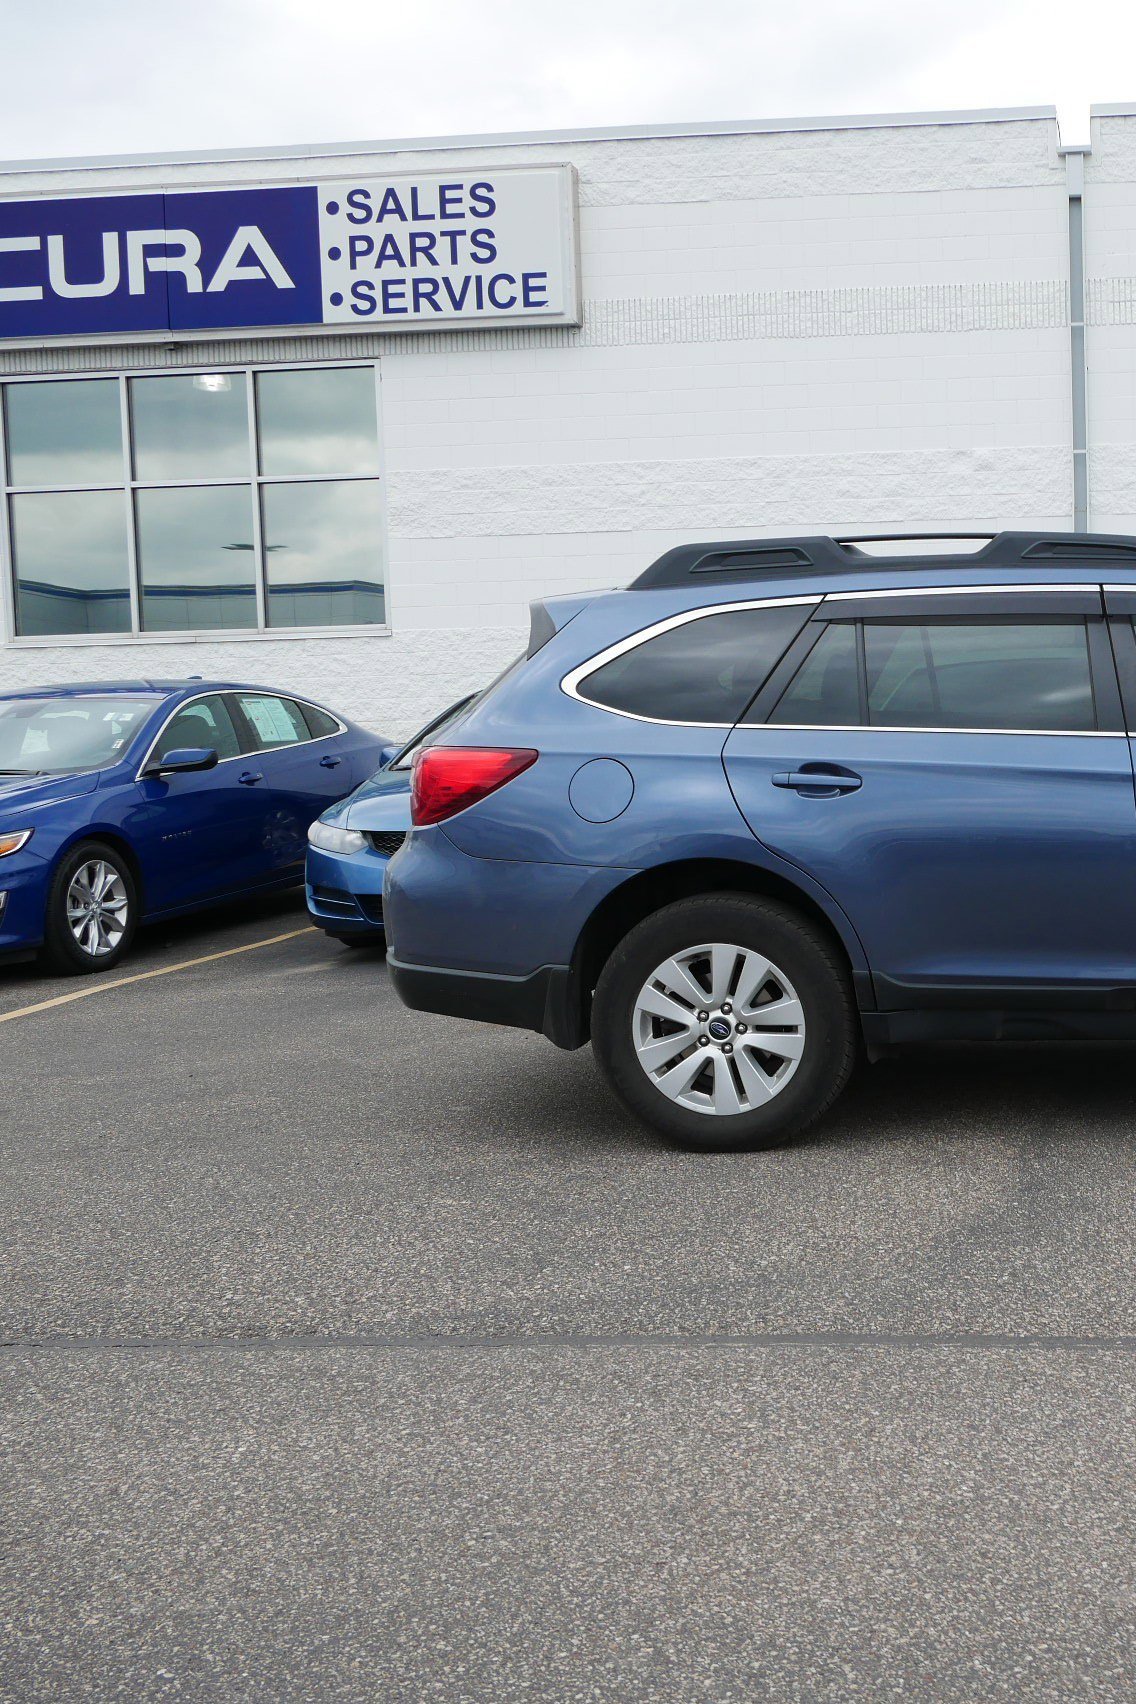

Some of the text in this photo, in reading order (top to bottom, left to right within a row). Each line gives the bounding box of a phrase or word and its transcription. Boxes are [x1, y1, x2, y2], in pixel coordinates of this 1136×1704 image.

[346, 182, 496, 225] SALES
[348, 228, 498, 271] PARTS
[350, 271, 550, 316] SERVICE
